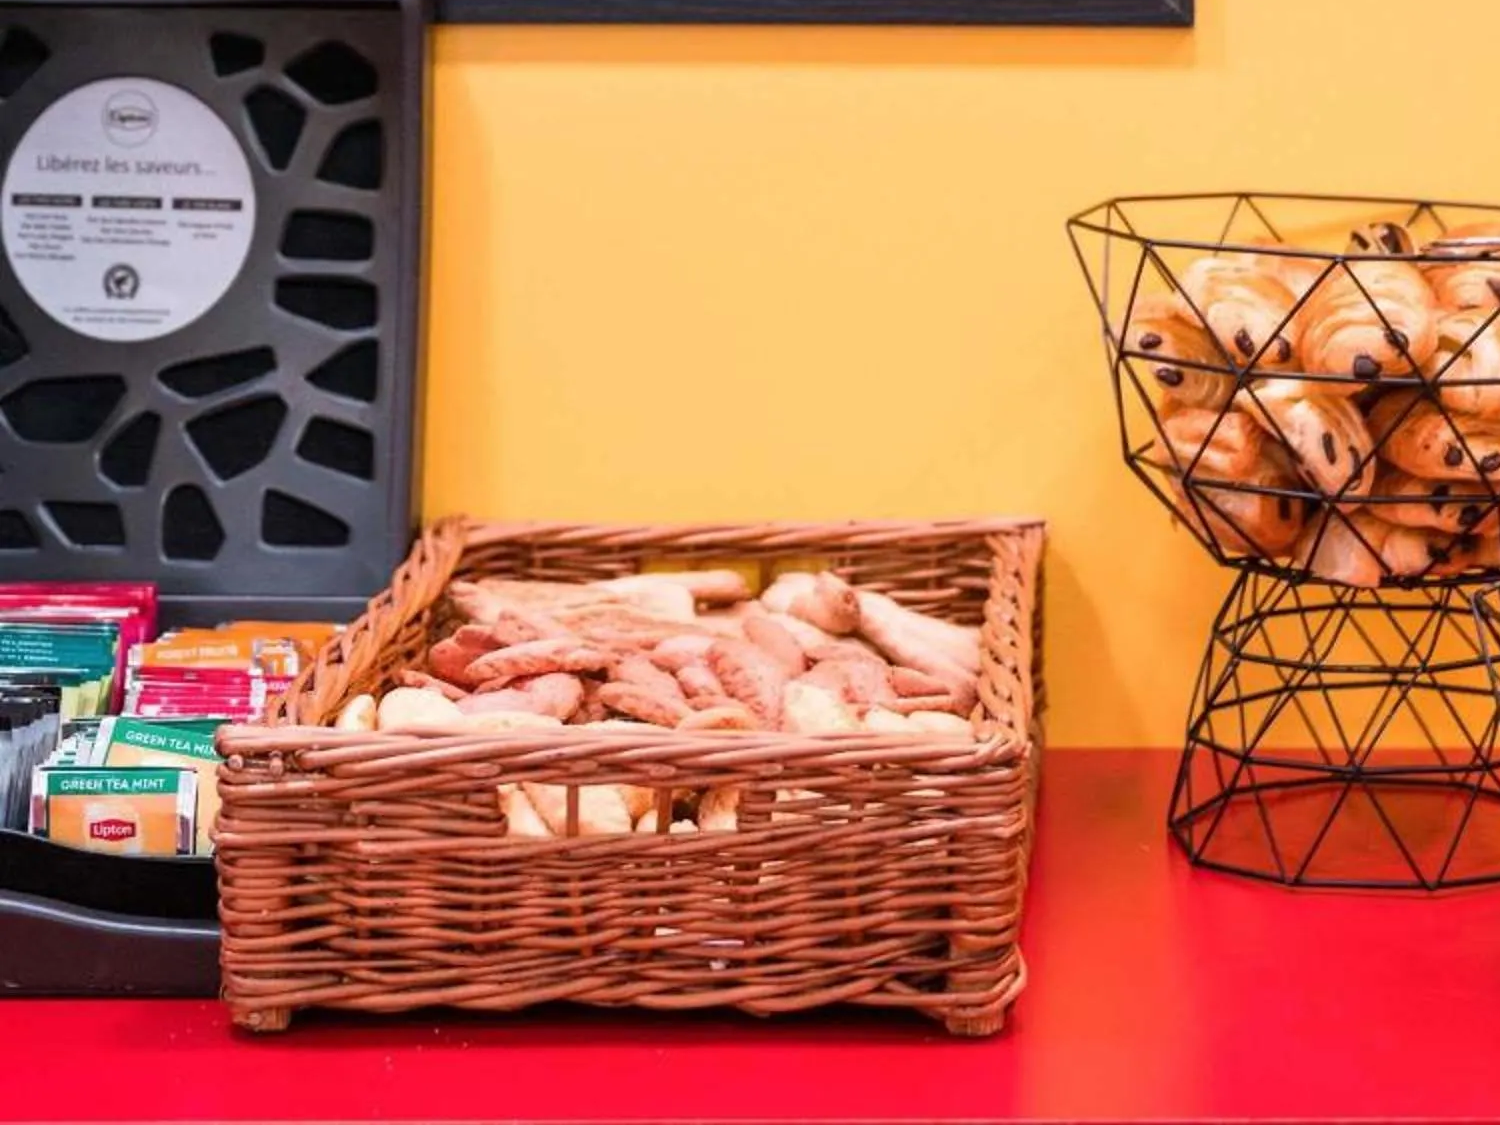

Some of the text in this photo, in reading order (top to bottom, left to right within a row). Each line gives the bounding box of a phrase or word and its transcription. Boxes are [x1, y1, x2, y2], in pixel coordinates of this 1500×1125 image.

[37, 155, 100, 173] Libérez
[105, 156, 128, 173] les
[125, 730, 218, 757] GREEN TEA MIN
[60, 777, 166, 791] GREEN TEA MINT
[93, 824, 133, 837] Lipton
